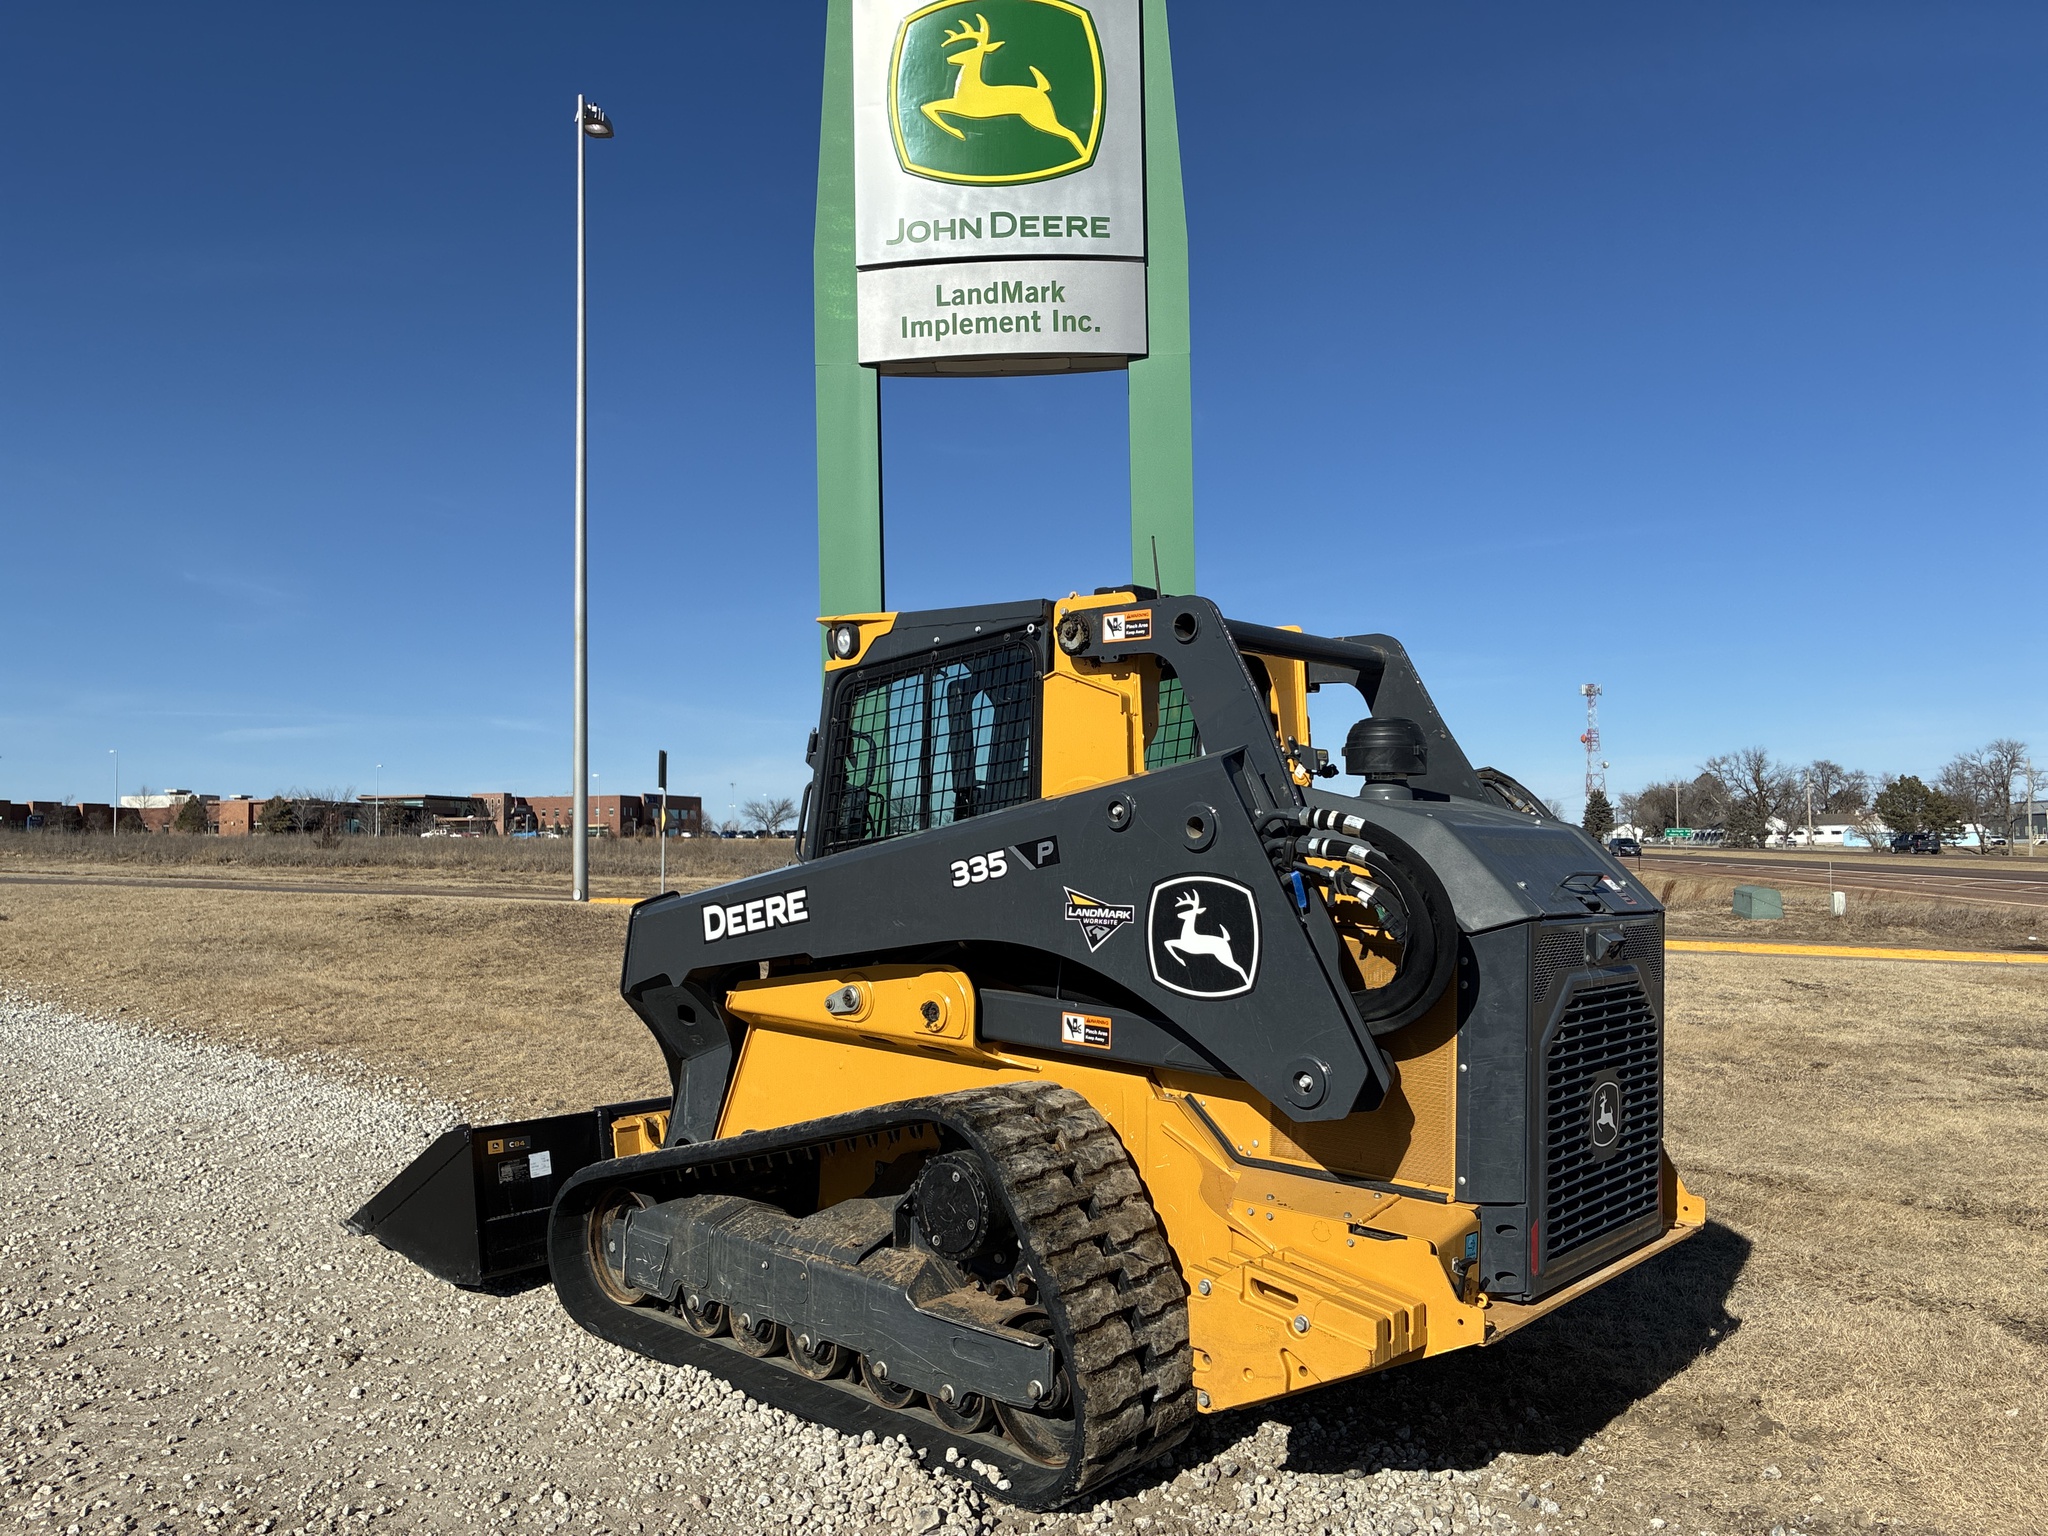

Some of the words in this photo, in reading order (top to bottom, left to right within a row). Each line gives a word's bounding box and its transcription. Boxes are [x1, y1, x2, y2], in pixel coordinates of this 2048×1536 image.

[886, 217, 982, 246] JOHN
[990, 211, 1111, 239] DEERE
[936, 280, 1066, 307] LandMark
[901, 310, 1041, 342] Implement
[1052, 309, 1101, 333] Inc.
[950, 849, 1008, 888] 335
[1037, 840, 1054, 865] P
[703, 889, 809, 942] DEERE
[1068, 906, 1131, 919] LANDMARK
[1083, 918, 1118, 926] WORKSITE
